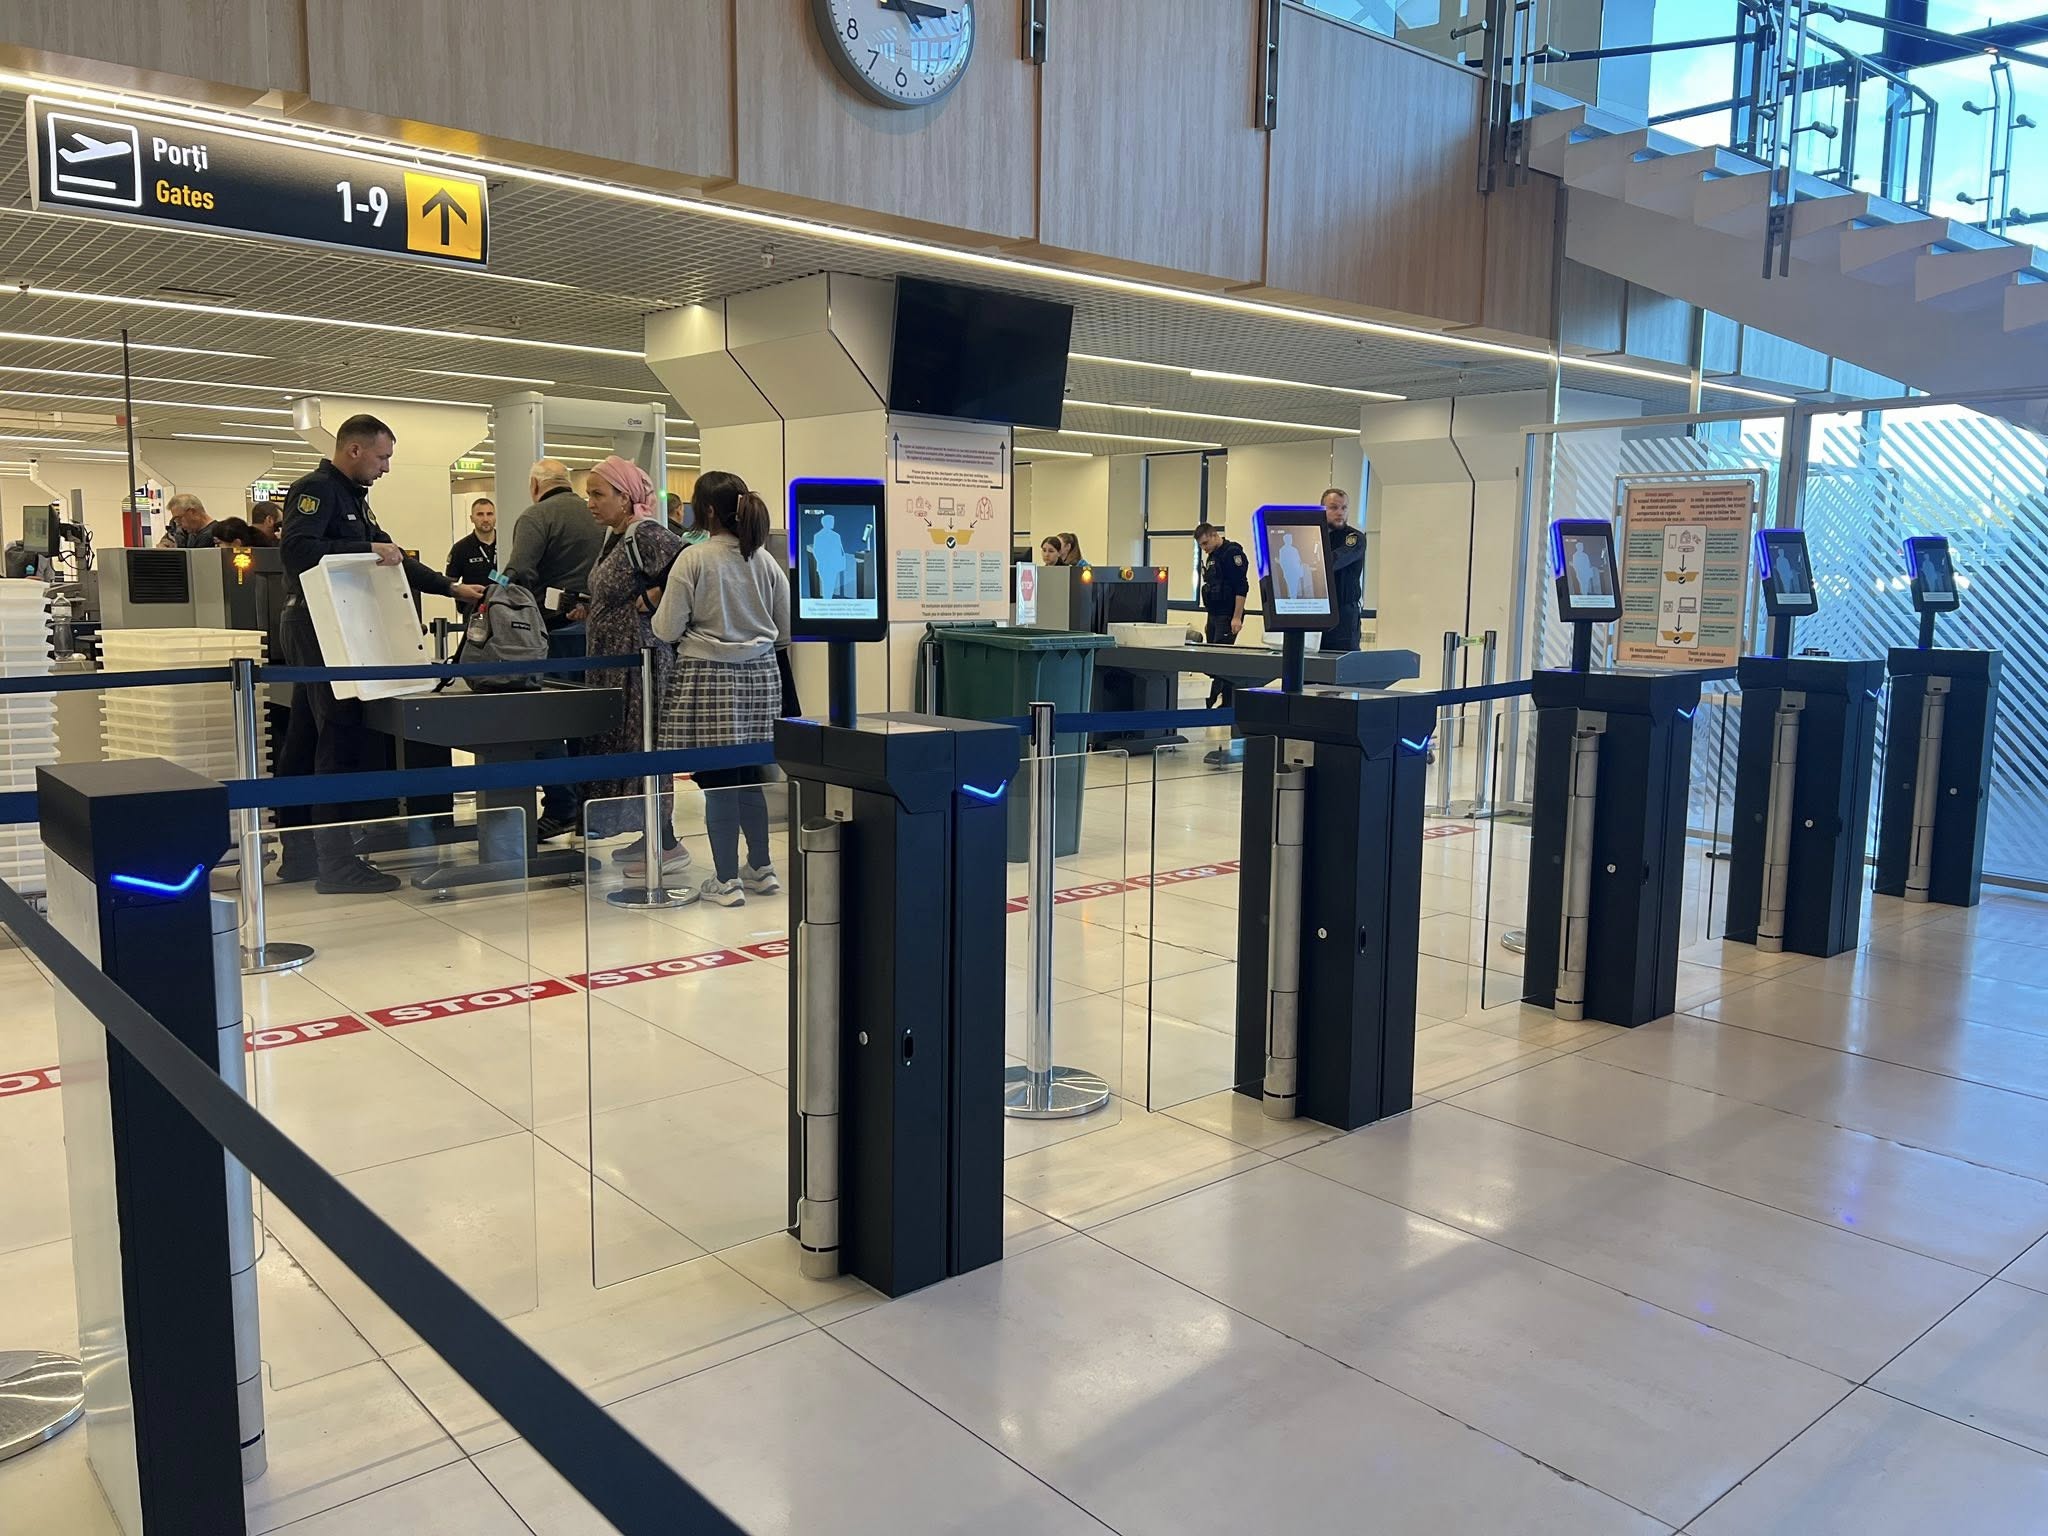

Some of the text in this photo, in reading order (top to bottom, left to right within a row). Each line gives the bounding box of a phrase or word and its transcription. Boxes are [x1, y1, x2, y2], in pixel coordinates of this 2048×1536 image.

[847, 18, 858, 40] 8
[868, 49, 880, 70] 7
[896, 67, 908, 88] 6
[156, 179, 214, 210] Gates
[336, 181, 388, 228] 1-9
[1136, 868, 1217, 884] STOP
[588, 950, 725, 986] STOP
[388, 984, 548, 1020] STOP
[246, 1022, 340, 1046] OP
